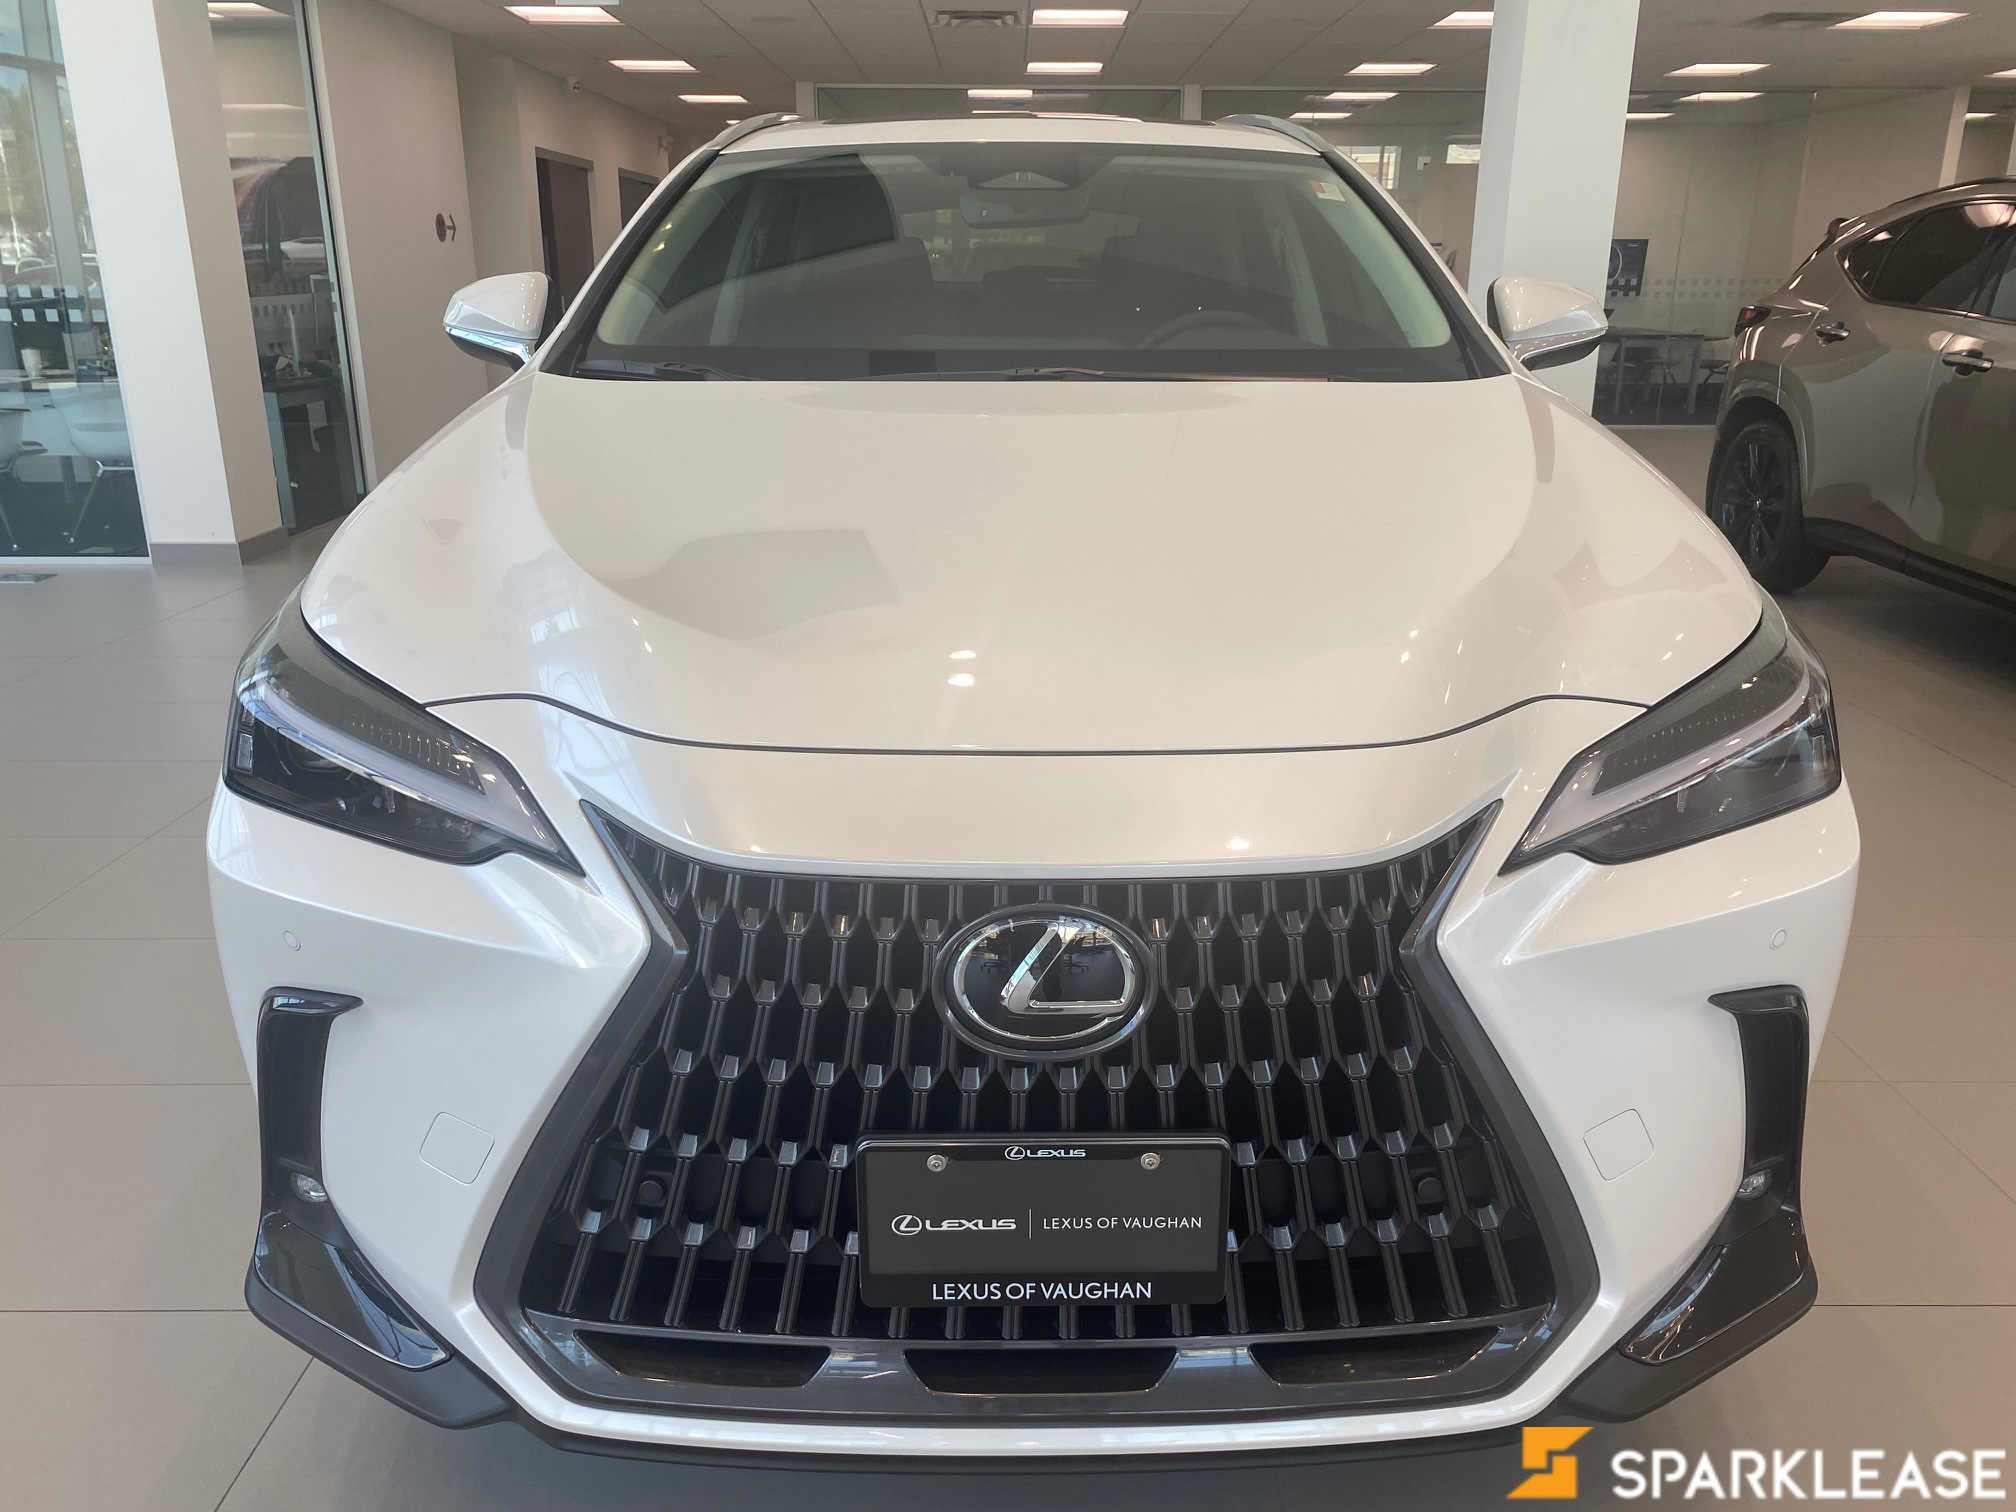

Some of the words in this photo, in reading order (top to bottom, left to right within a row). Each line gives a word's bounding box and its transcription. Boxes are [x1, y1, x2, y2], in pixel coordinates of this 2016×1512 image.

[1026, 1148, 1086, 1158] LEXUS
[925, 1218, 1017, 1232] LEXUS
[1043, 1217, 1093, 1230] LEXUS
[1096, 1217, 1119, 1229] OF
[1122, 1216, 1202, 1229] VAUGHAN
[932, 1282, 1001, 1300] LEXUS
[1005, 1282, 1036, 1300] OF
[1040, 1281, 1152, 1300] VAUGHAN
